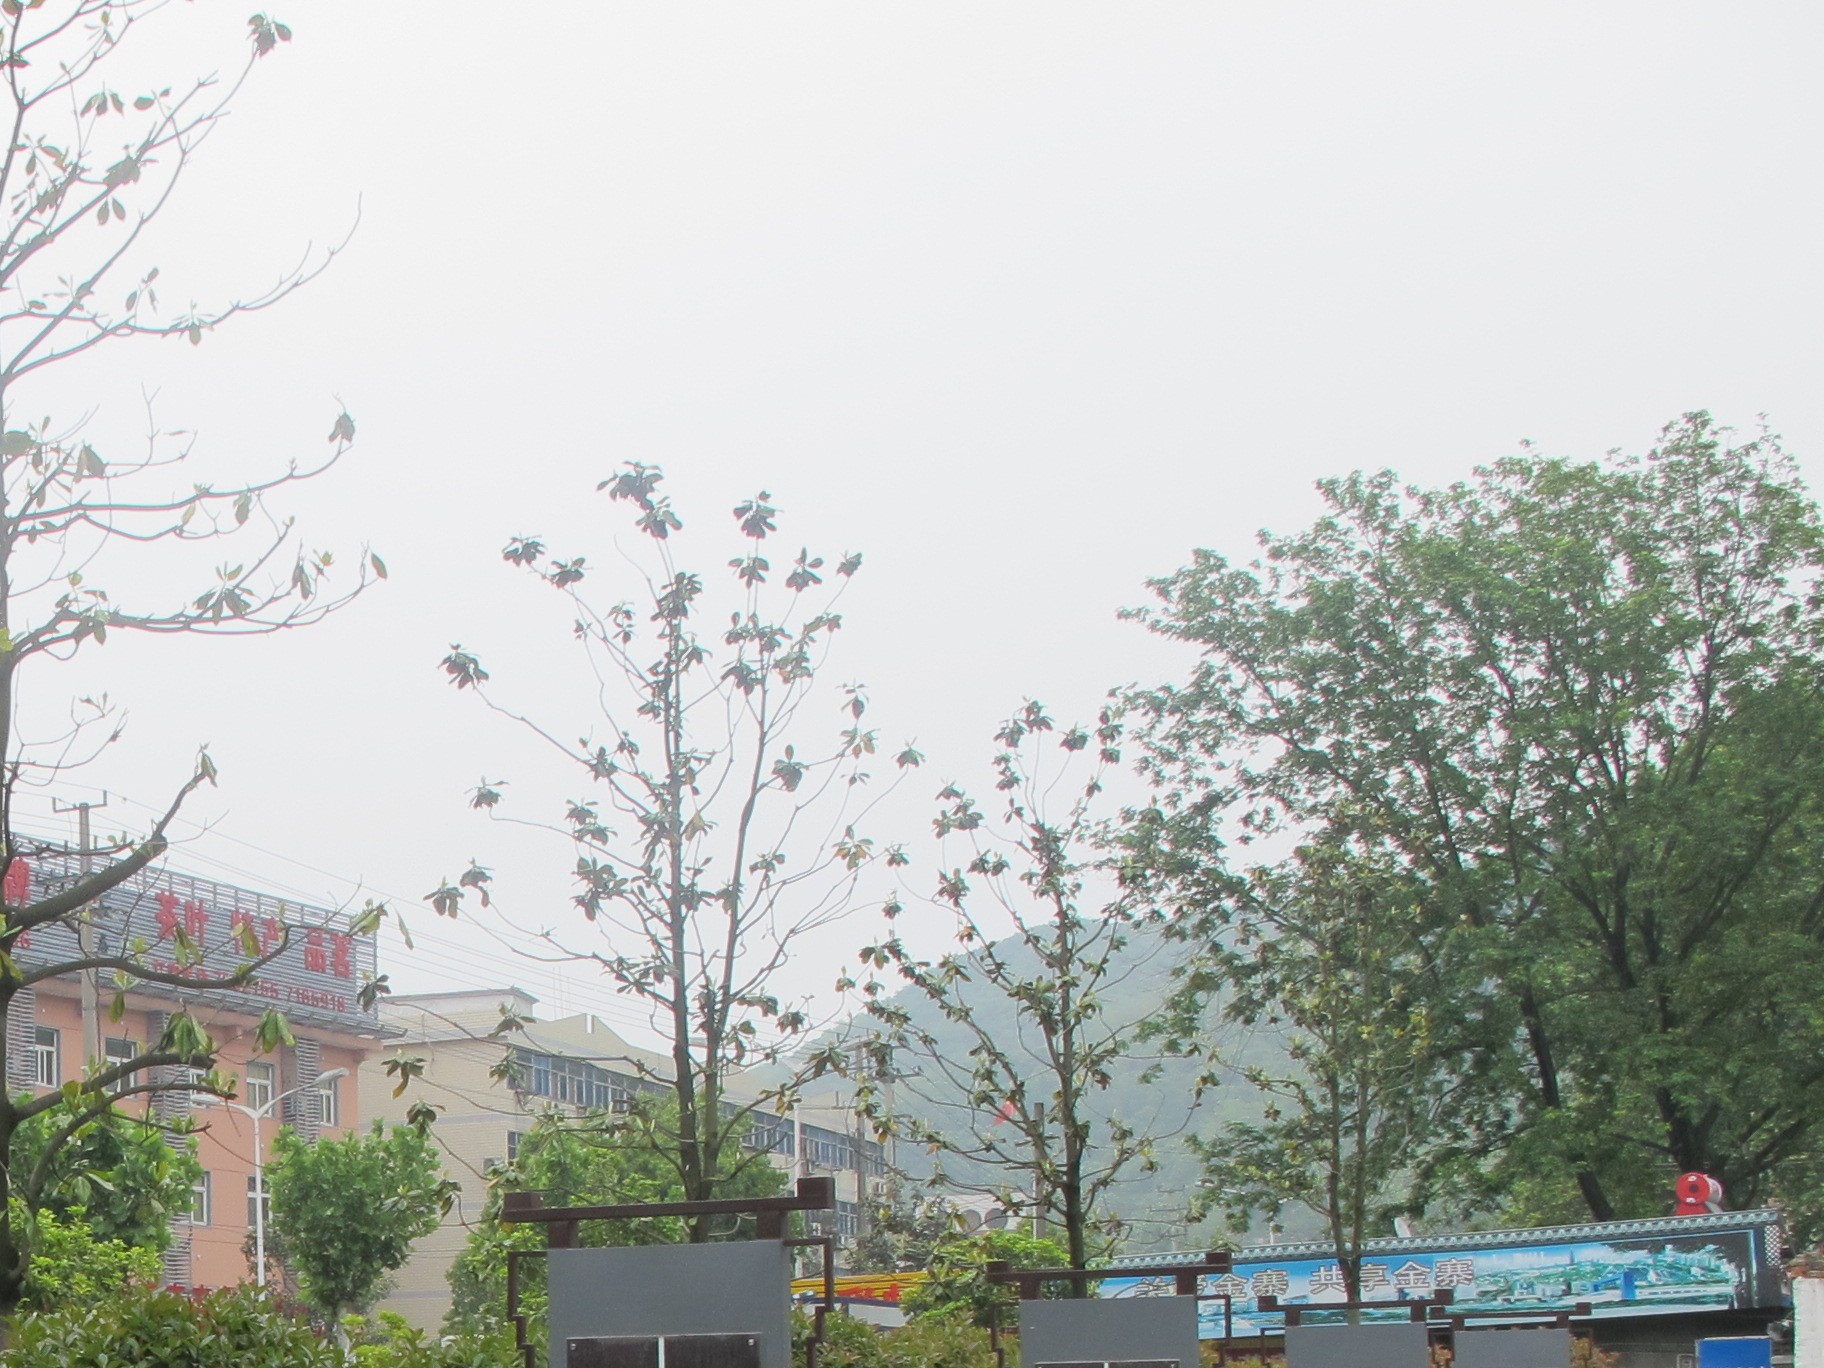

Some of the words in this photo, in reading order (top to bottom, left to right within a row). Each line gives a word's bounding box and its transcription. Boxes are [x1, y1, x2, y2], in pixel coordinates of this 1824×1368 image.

[155, 890, 210, 947] 茶叶
[1309, 1257, 1476, 1295] 共享金寨
